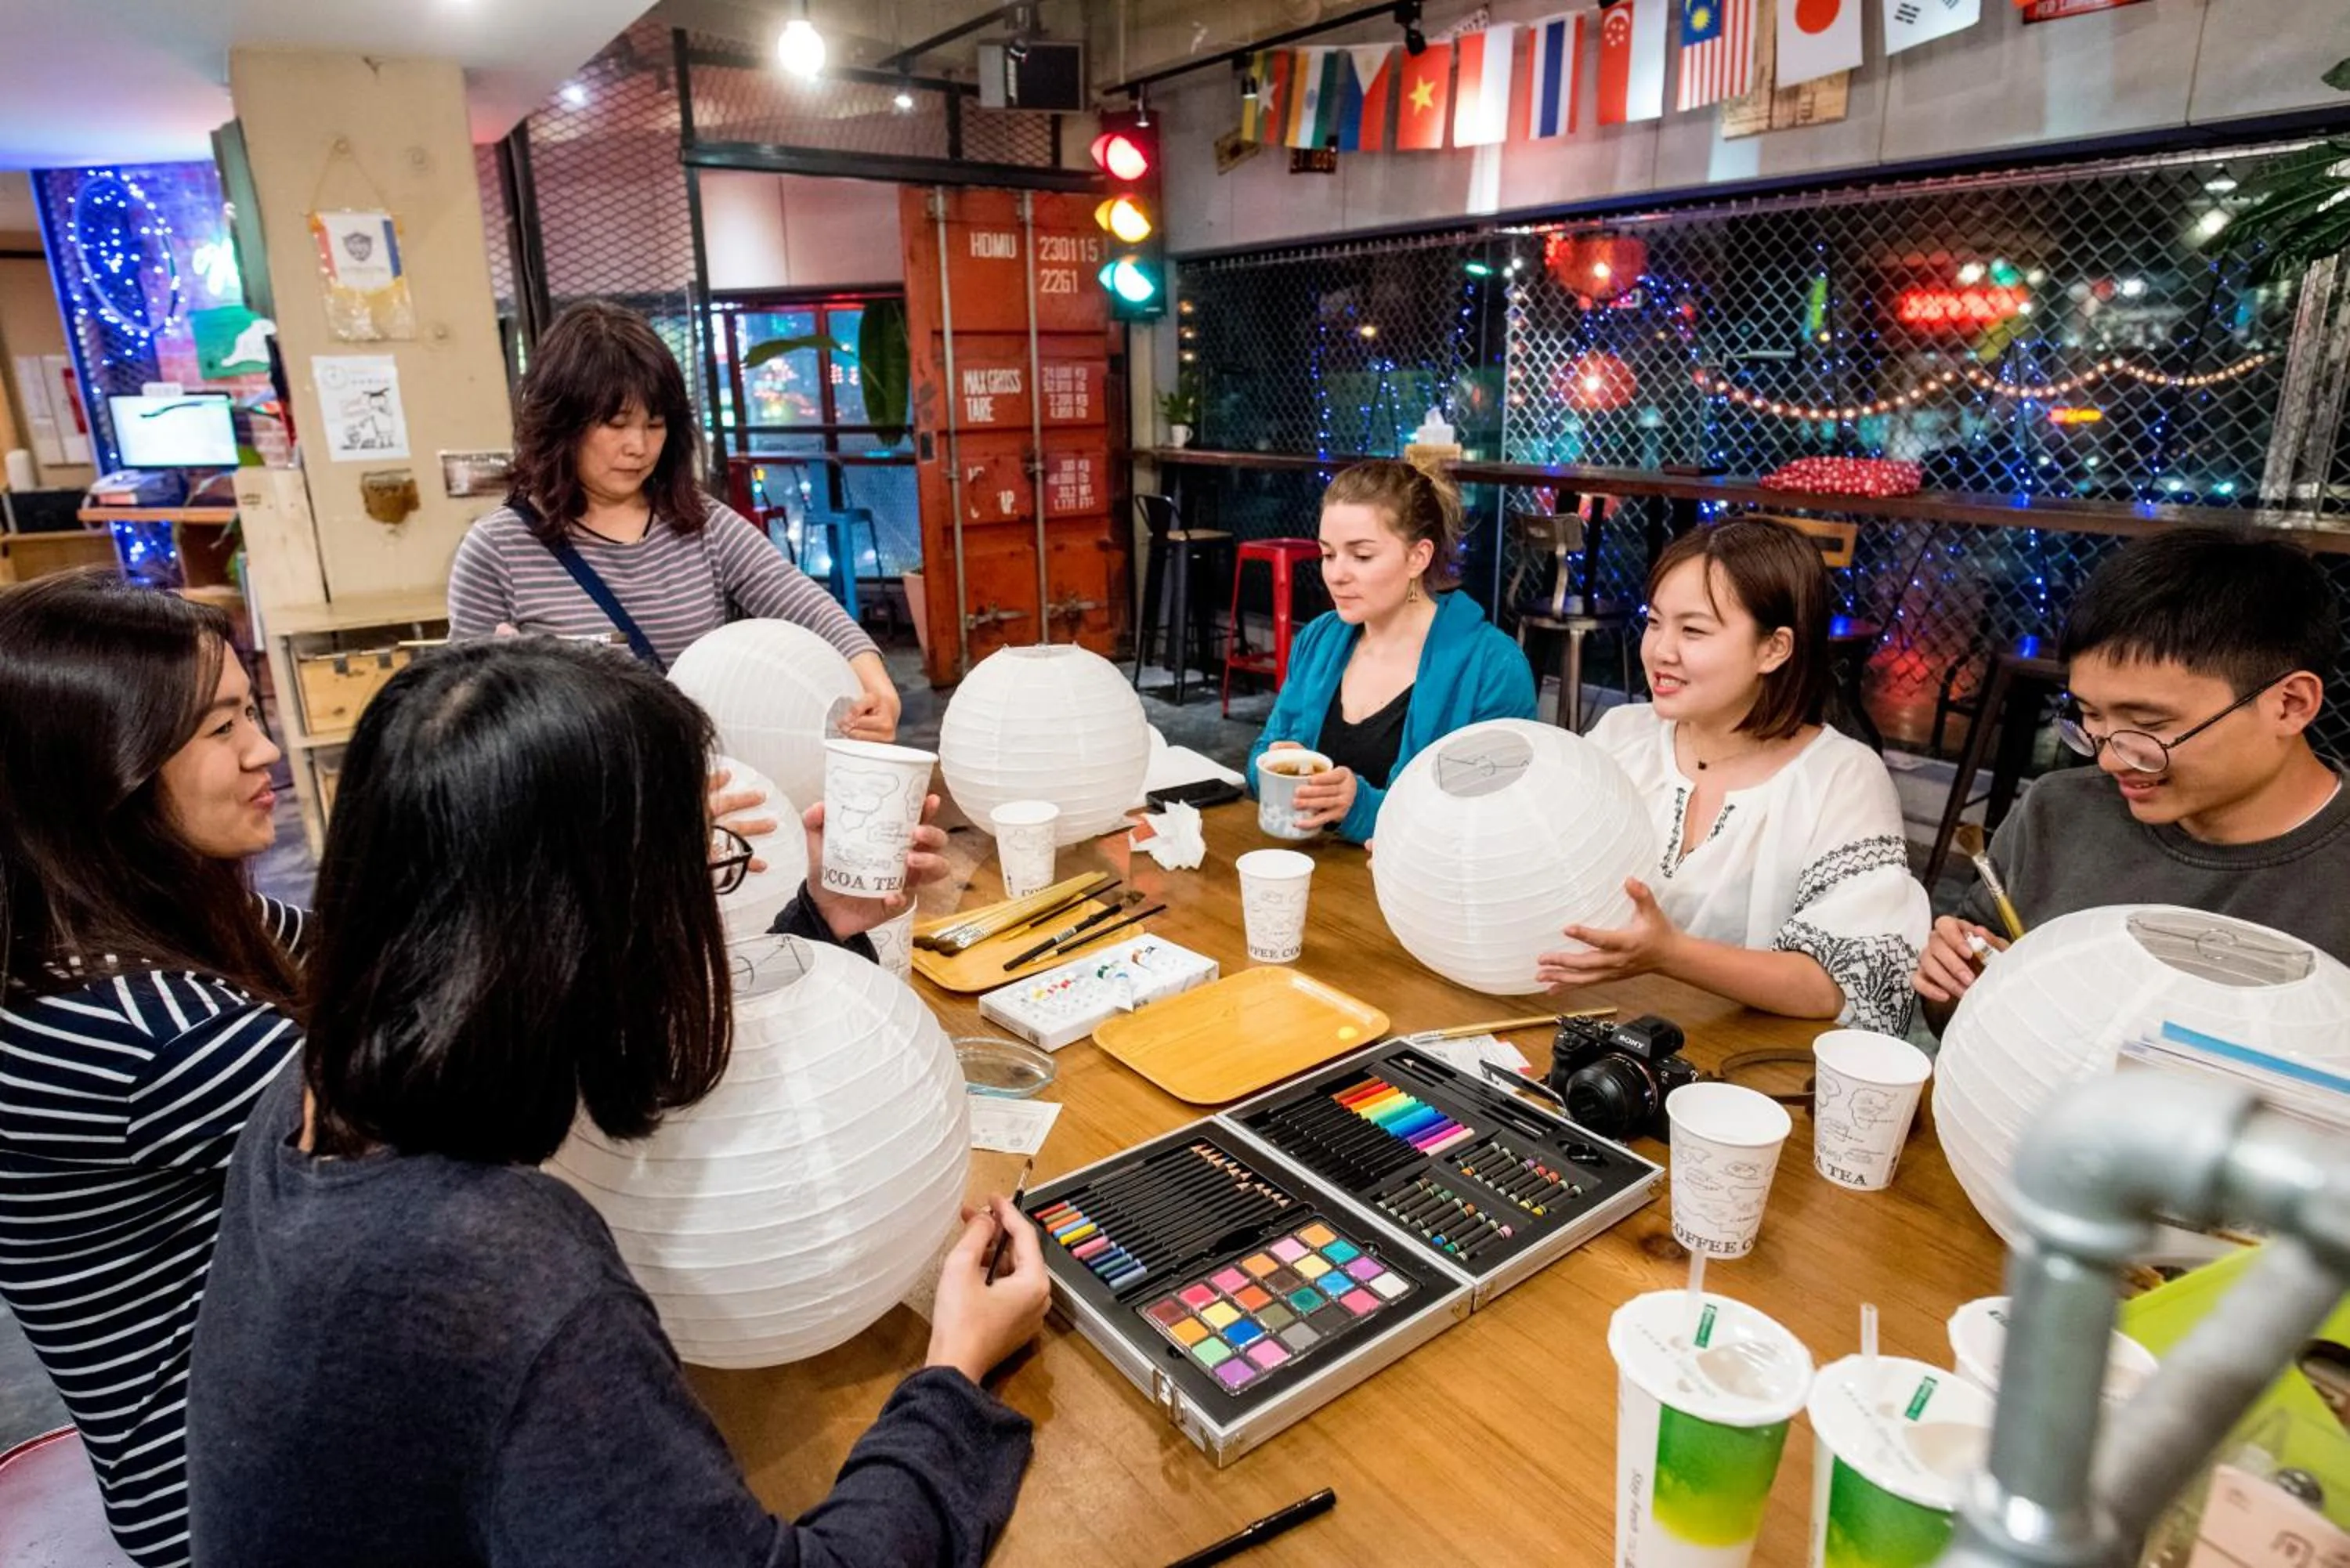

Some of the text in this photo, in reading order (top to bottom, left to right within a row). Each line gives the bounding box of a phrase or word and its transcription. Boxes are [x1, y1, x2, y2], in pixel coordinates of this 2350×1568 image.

[971, 232, 1098, 262] HDMU 230115
[964, 396, 995, 423] TARE
[824, 867, 866, 891] COA
[1618, 1034, 1645, 1050] SONY
[1828, 1164, 1867, 1187] TEA
[1672, 1221, 1737, 1254] OFFEE
